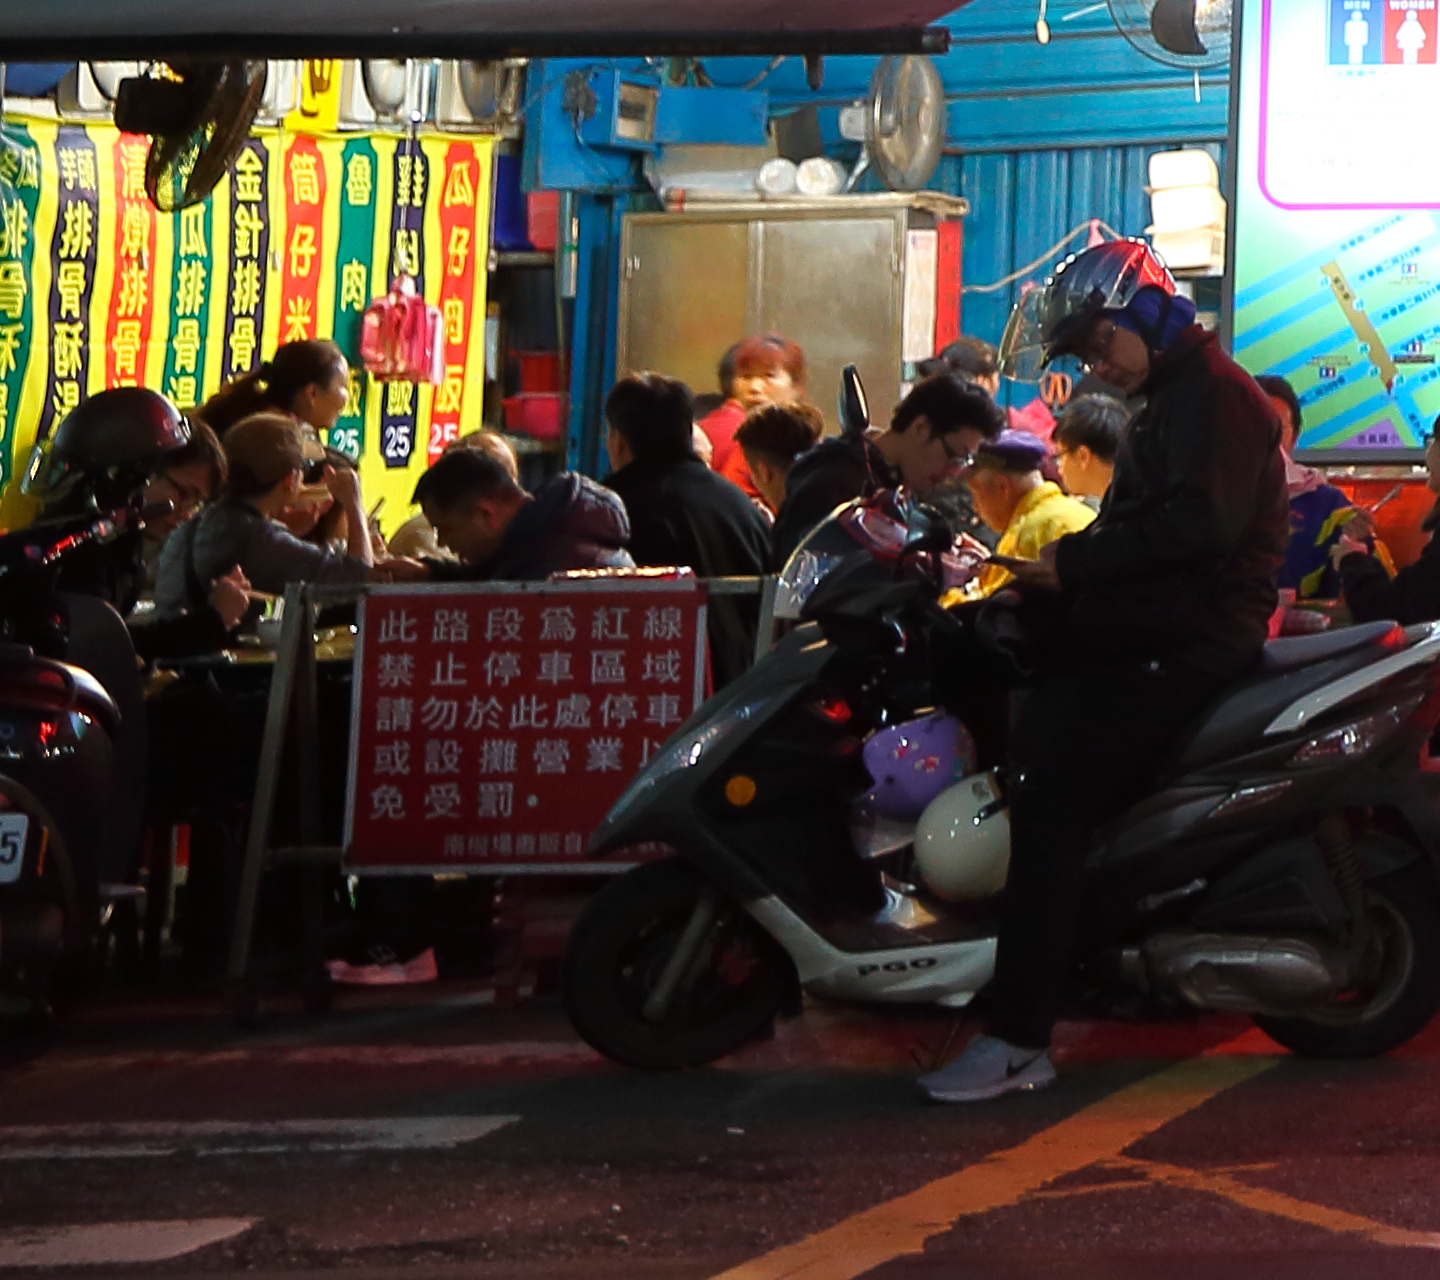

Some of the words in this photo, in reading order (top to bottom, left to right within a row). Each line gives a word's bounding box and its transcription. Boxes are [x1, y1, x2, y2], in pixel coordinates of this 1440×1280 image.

[1344, 0, 1371, 11] MEN
[1389, 0, 1436, 11] WOMEN
[385, 425, 411, 458] 25
[377, 650, 682, 688] 禁止停車區域
[375, 693, 682, 733] 請勿於此處停車
[858, 957, 938, 976] PGO
